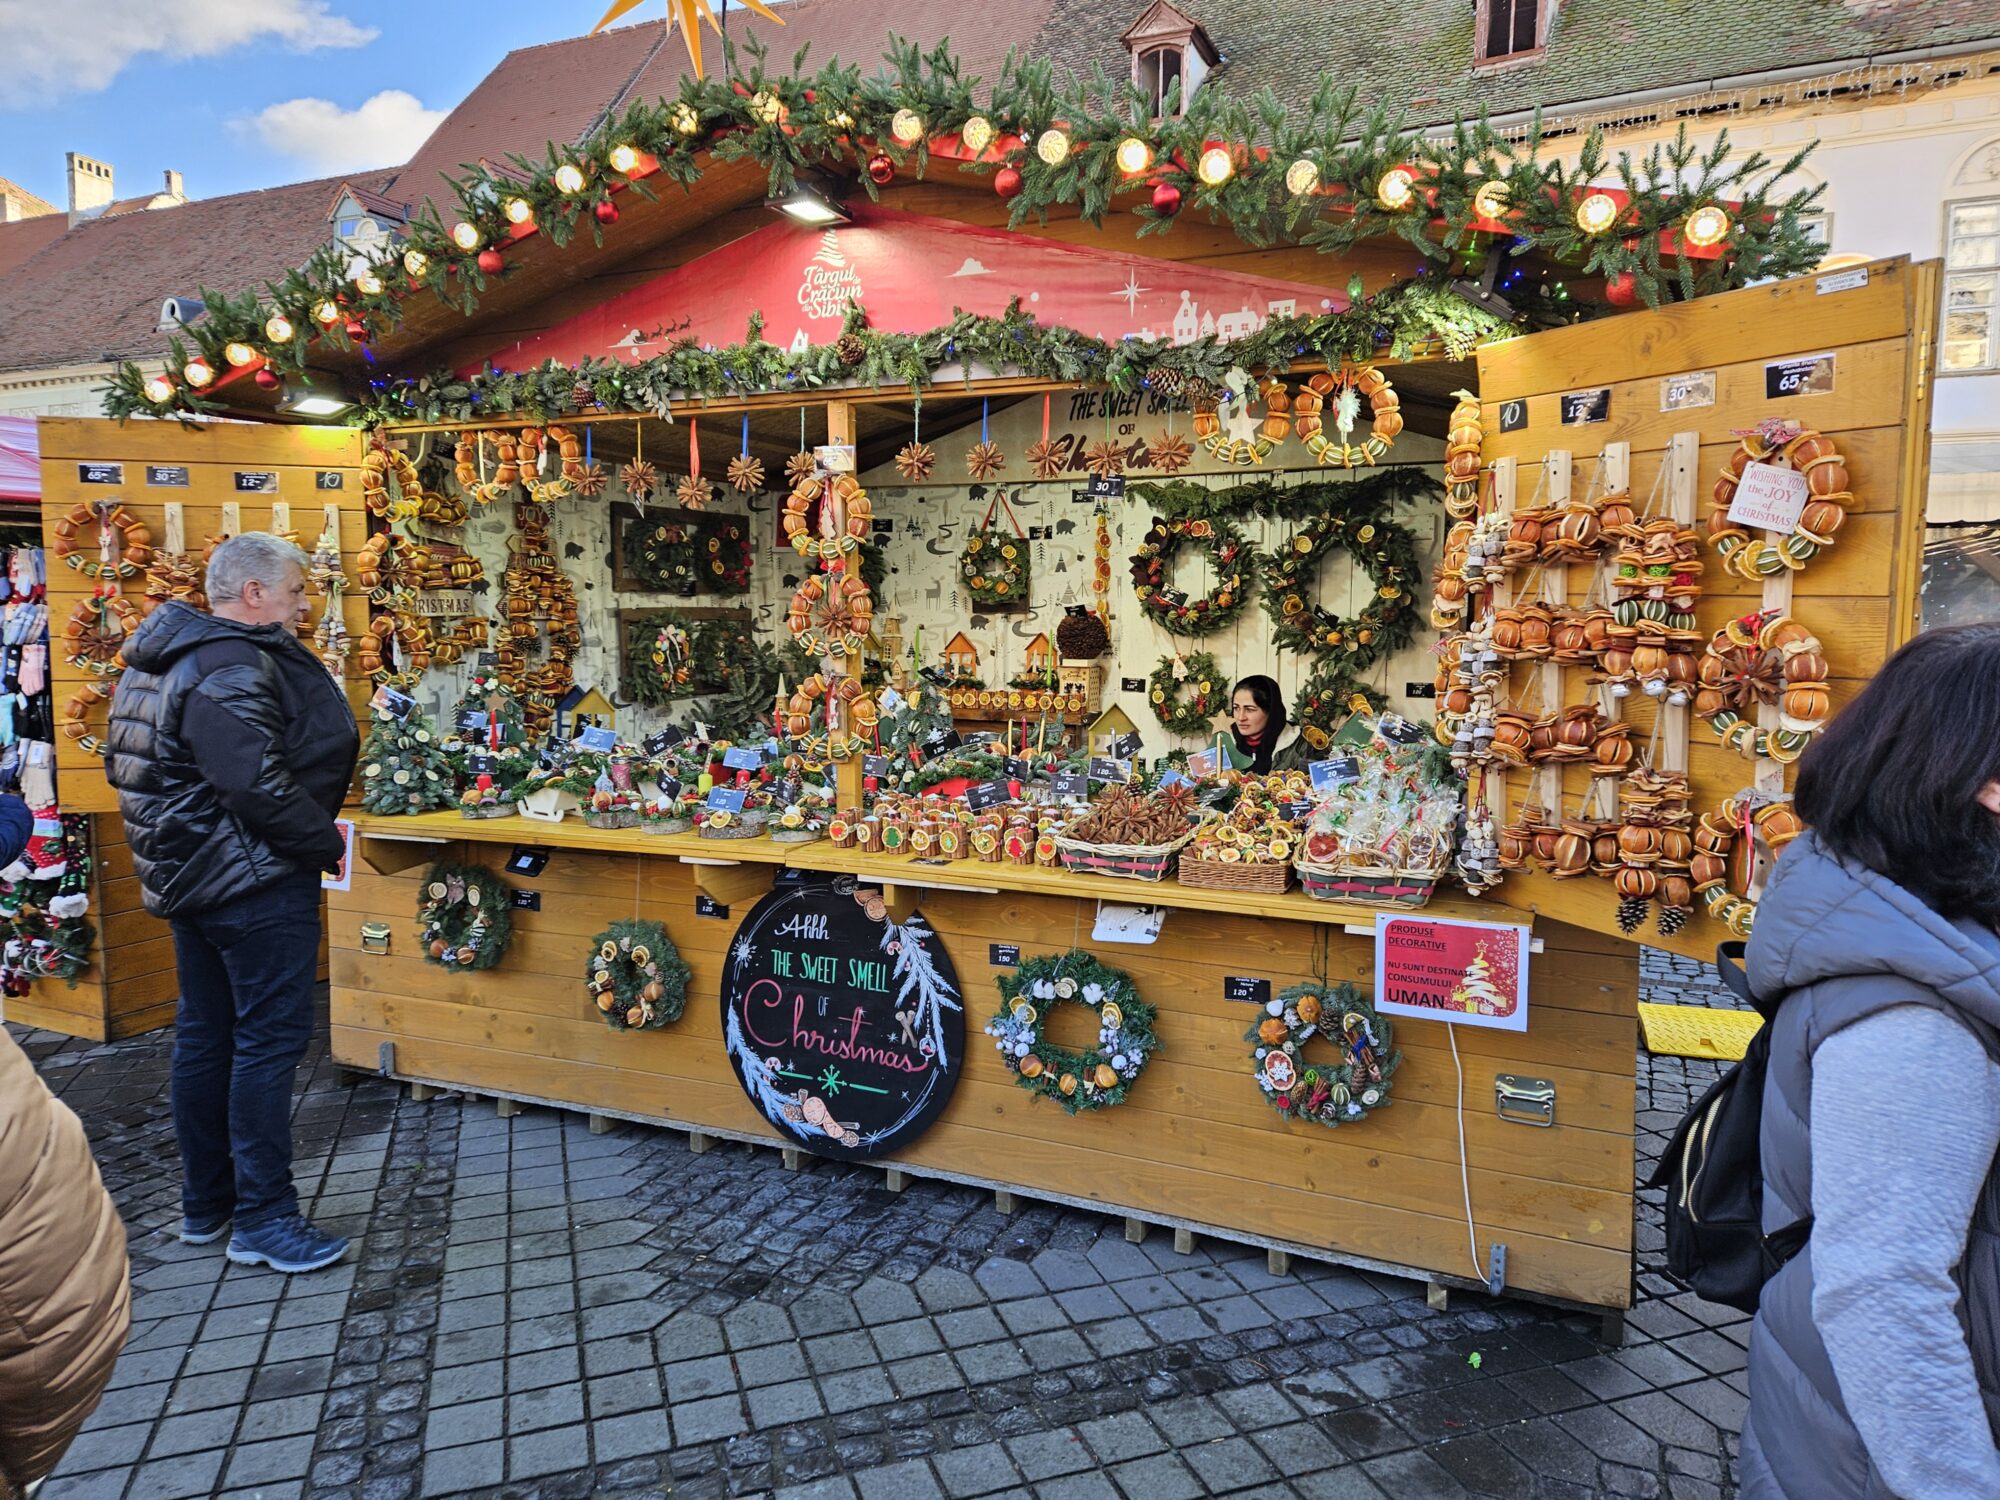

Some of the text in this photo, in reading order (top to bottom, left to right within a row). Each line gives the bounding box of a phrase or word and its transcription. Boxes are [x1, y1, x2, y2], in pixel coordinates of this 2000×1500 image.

[803, 263, 855, 288] Târgul
[797, 283, 864, 305] Crăciun
[1779, 374, 1800, 391] 65
[1668, 387, 1687, 401] 30
[1069, 391, 1099, 421] THE
[1099, 388, 1144, 418] SWEET
[1568, 404, 1584, 418] 12
[1500, 402, 1520, 426] 10
[1118, 423, 1135, 436] OF
[241, 478, 256, 486] 12
[1095, 482, 1109, 491] 30
[1750, 469, 1805, 490] WISHING YOU
[1747, 484, 1798, 502] the JOY
[1737, 506, 1792, 526] CHRISTMAS
[1056, 781, 1069, 790] 50
[774, 913, 830, 940] Ahhh
[1391, 924, 1435, 937] PRODUSE
[1388, 937, 1448, 951] DECORATIVE
[770, 949, 890, 993] THE SWEET SMELL
[1387, 960, 1474, 977] NU SUNT DESTINATE
[1387, 972, 1452, 987] CONSUMULUI
[817, 996, 829, 1017] OF
[1388, 988, 1445, 1009] UMAN
[743, 978, 929, 1073] Christmas
